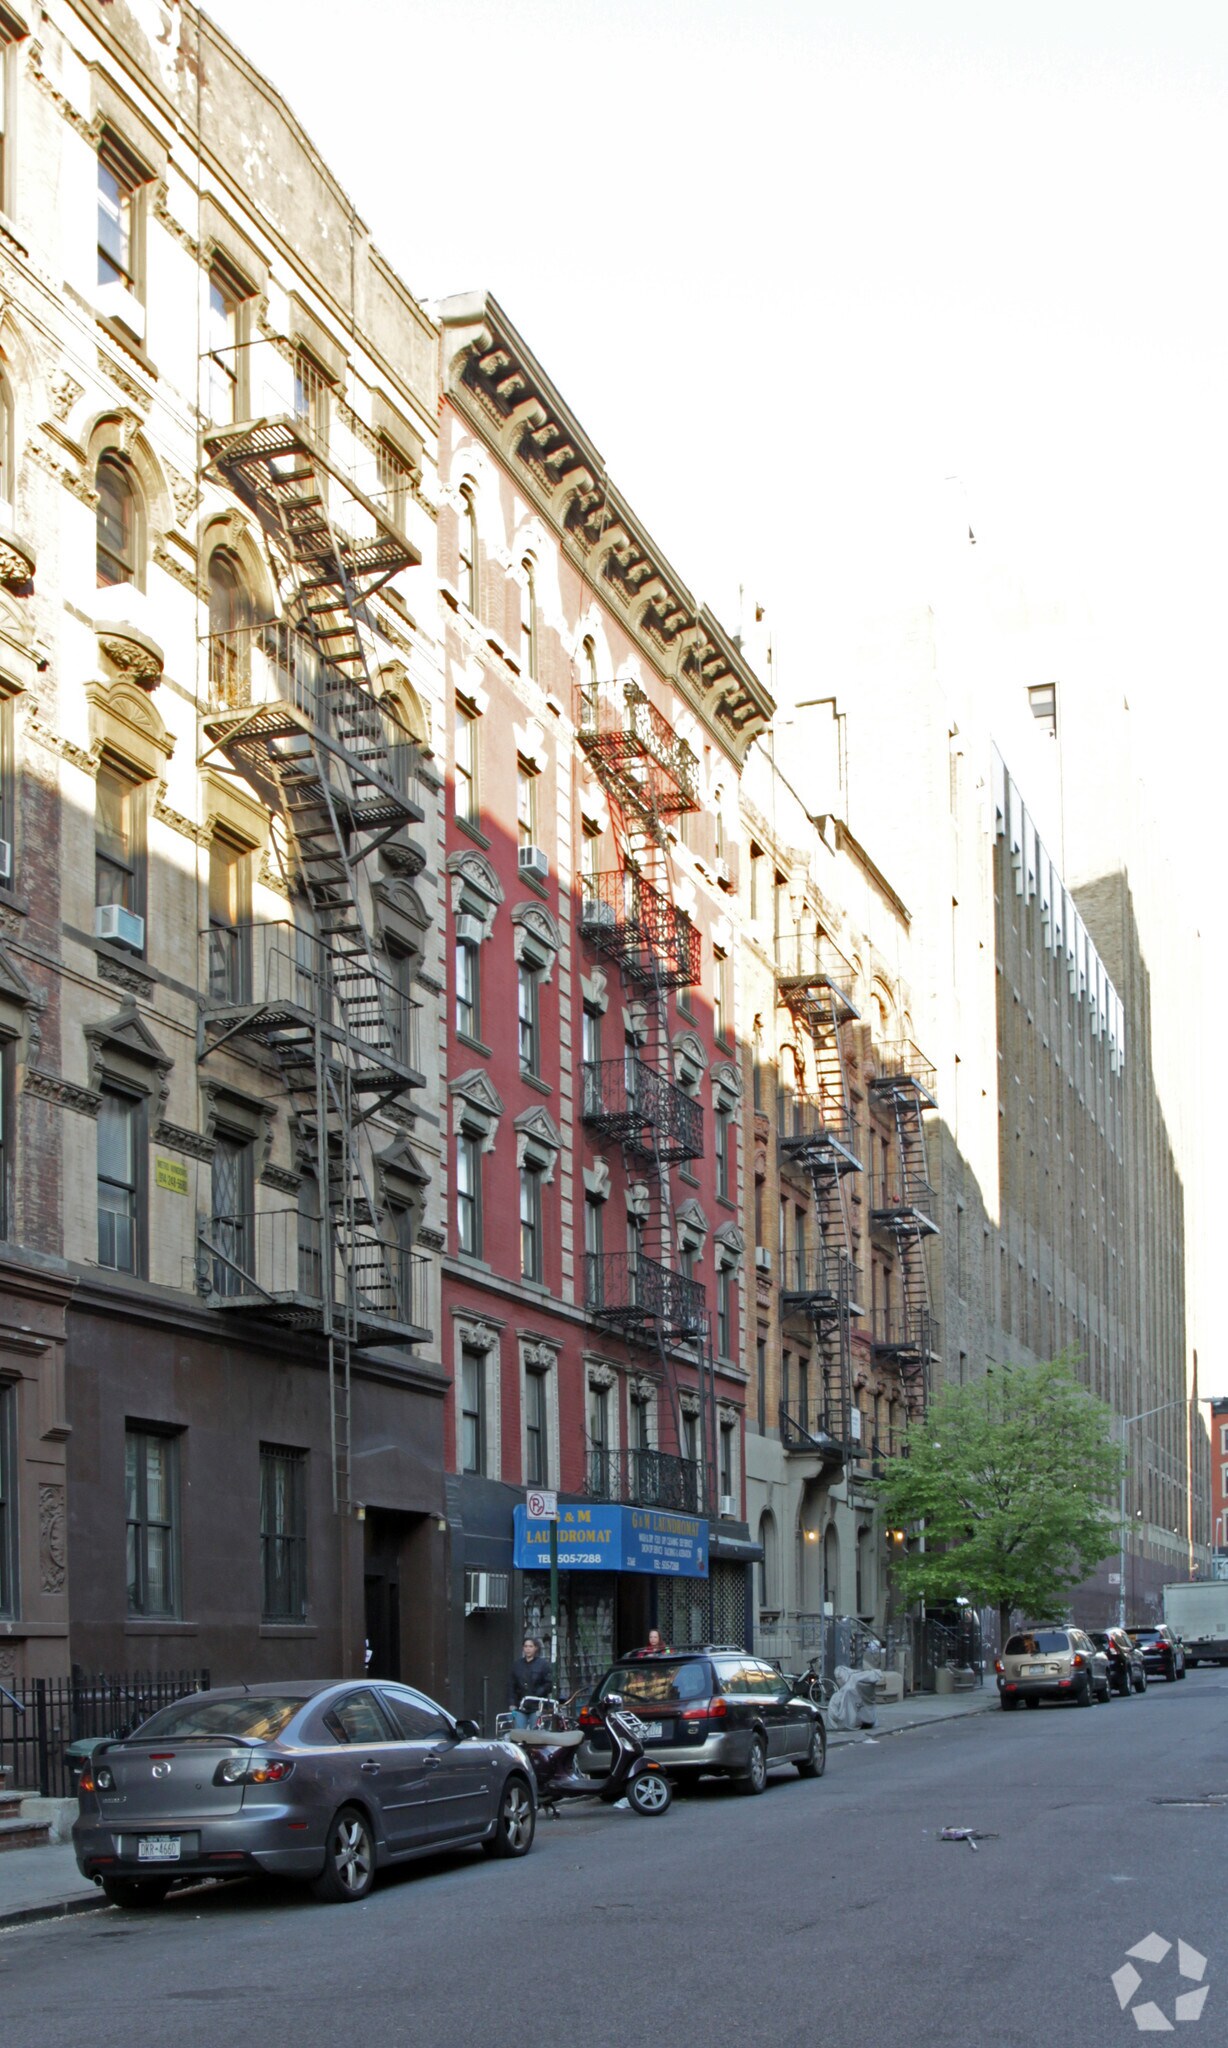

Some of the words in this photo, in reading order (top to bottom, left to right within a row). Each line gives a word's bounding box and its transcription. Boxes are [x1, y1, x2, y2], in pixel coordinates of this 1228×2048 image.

[578, 1510, 591, 1523] M
[527, 1529, 612, 1543] LAUDROMAT
[557, 1553, 602, 1564] 505-7288
